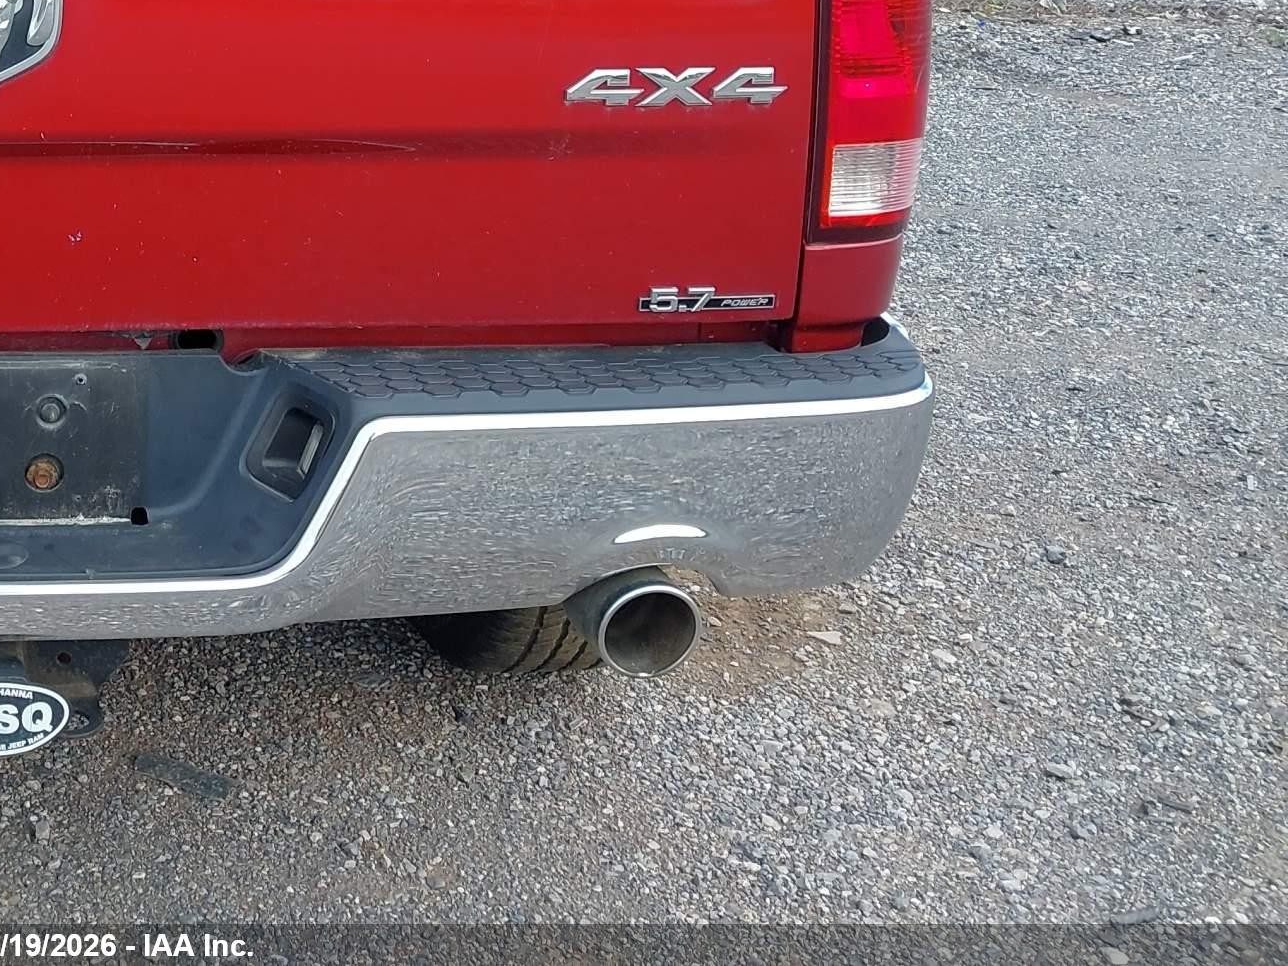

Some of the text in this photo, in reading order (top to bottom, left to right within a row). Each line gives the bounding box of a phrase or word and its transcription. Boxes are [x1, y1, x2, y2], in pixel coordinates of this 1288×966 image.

[565, 66, 789, 107] 4X4
[649, 286, 770, 313] 5.7 POWER
[8, 740, 27, 750] JEEP
[28, 732, 45, 745] RAM
